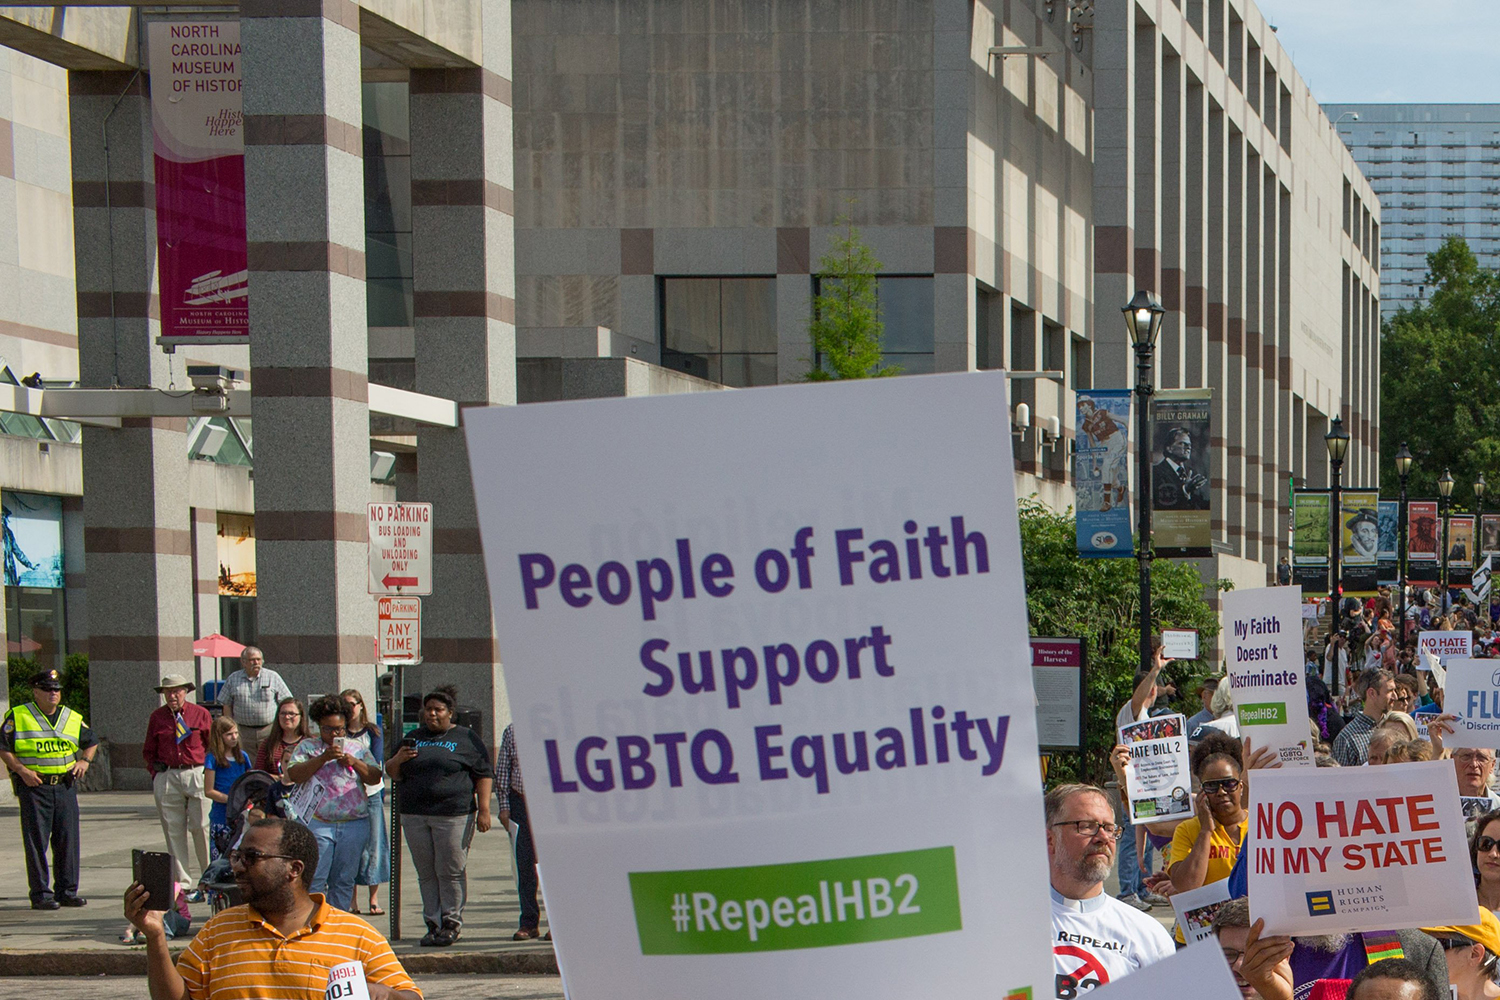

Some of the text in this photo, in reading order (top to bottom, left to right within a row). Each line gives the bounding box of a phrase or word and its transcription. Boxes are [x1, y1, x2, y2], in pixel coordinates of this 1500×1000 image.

[171, 25, 219, 38] NORTH
[171, 43, 242, 56] CAROLINA
[172, 61, 235, 74] MUSEUM
[172, 79, 191, 92] OF
[209, 125, 236, 136] Here
[1156, 411, 1208, 421] BILLY GRAHAM
[370, 506, 429, 522] NO PARKING
[378, 525, 421, 537] BUS LOADING
[393, 537, 407, 548] AND
[381, 549, 418, 560] UNLOADING
[391, 560, 408, 571] ONLY
[517, 515, 991, 621] People of Faith
[379, 601, 417, 615] NO PARKING
[387, 623, 411, 636] ANY
[1234, 616, 1281, 641] My Faith
[386, 637, 413, 650] TIME
[1421, 638, 1467, 647] NO HATE
[639, 625, 896, 709] Support
[1230, 669, 1298, 689] Discriminate
[36, 740, 71, 753] POLIC
[544, 704, 1011, 795] LGBTQ Equality
[1128, 741, 1181, 759] HATE BILL 2
[1279, 750, 1303, 758] LGBTQ
[1256, 794, 1440, 841] NO HATE
[1256, 836, 1447, 874] IN MY STATE
[1337, 885, 1382, 896] HUMAN
[1339, 895, 1385, 906] RIGHTS
[671, 873, 921, 942] #RepealHB2
